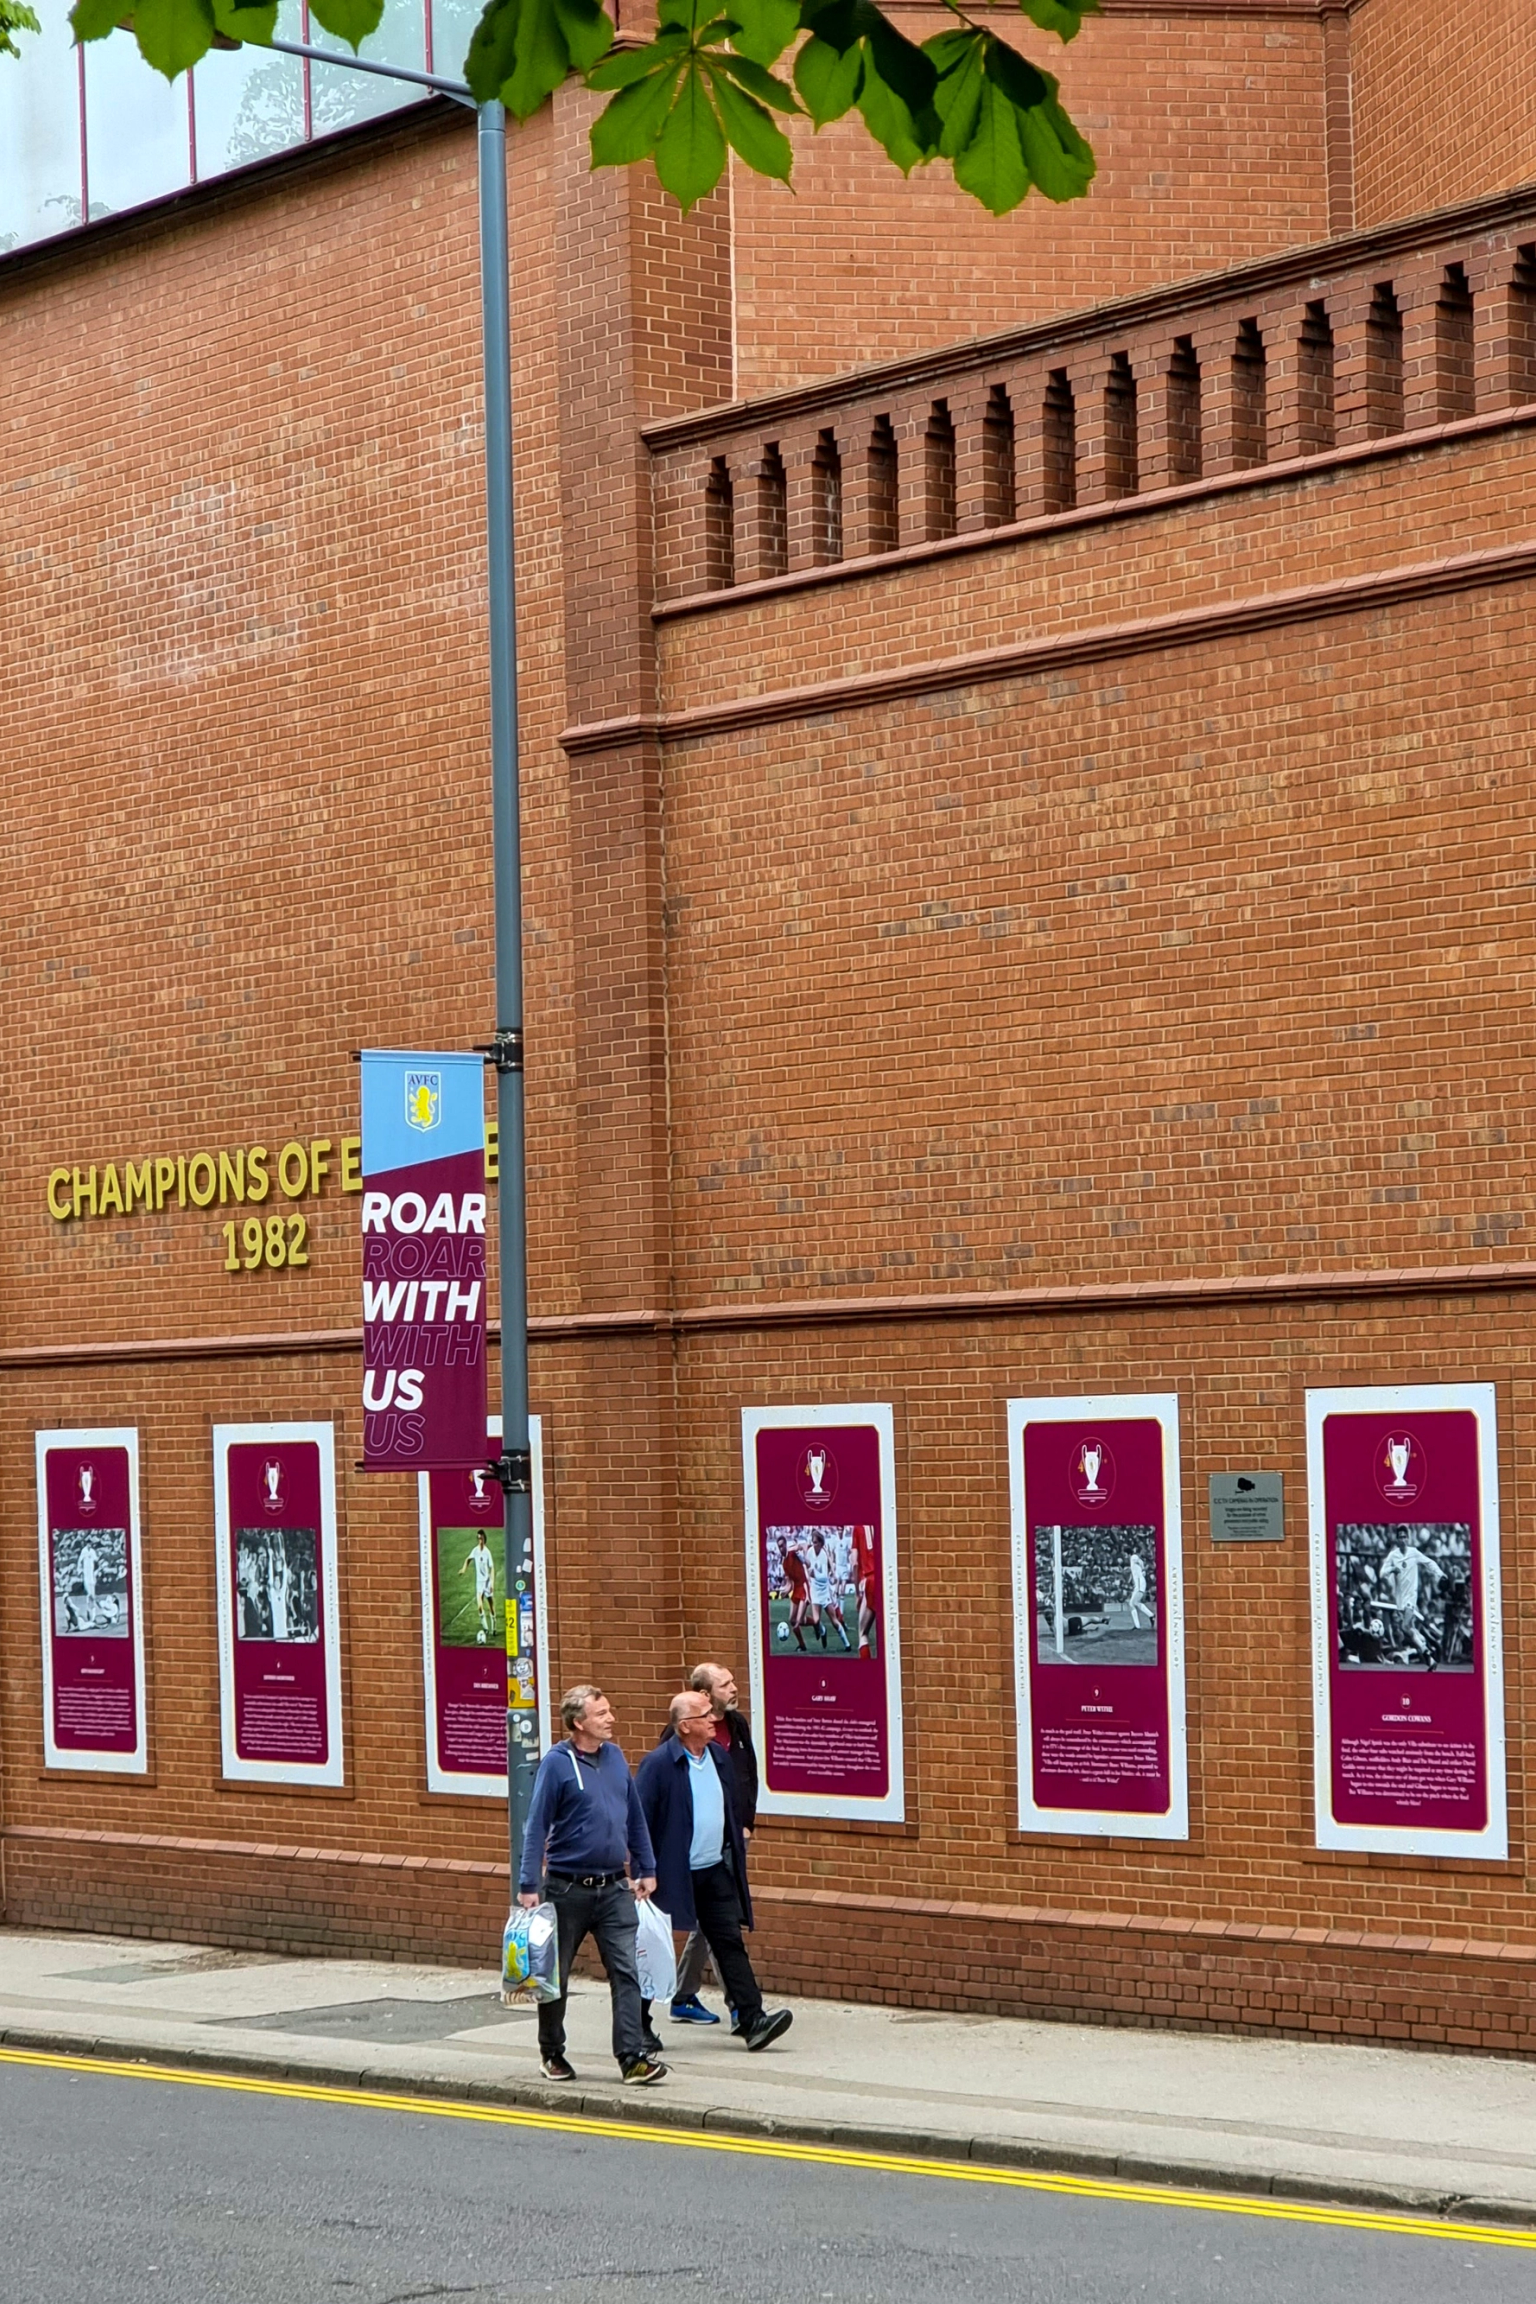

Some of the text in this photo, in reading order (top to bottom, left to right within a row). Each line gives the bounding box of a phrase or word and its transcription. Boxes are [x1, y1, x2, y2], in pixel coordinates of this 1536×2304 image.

[408, 1074, 438, 1086] AVFC
[47, 1146, 269, 1219] CHAMPIONS
[278, 1139, 331, 1197] OF
[362, 1192, 486, 1234] ROAR
[222, 1213, 308, 1270] 1982
[363, 1236, 487, 1278] ROAR
[362, 1281, 481, 1322] WITH
[363, 1325, 482, 1366] WITH
[362, 1369, 425, 1411] US
[363, 1413, 426, 1456] US
